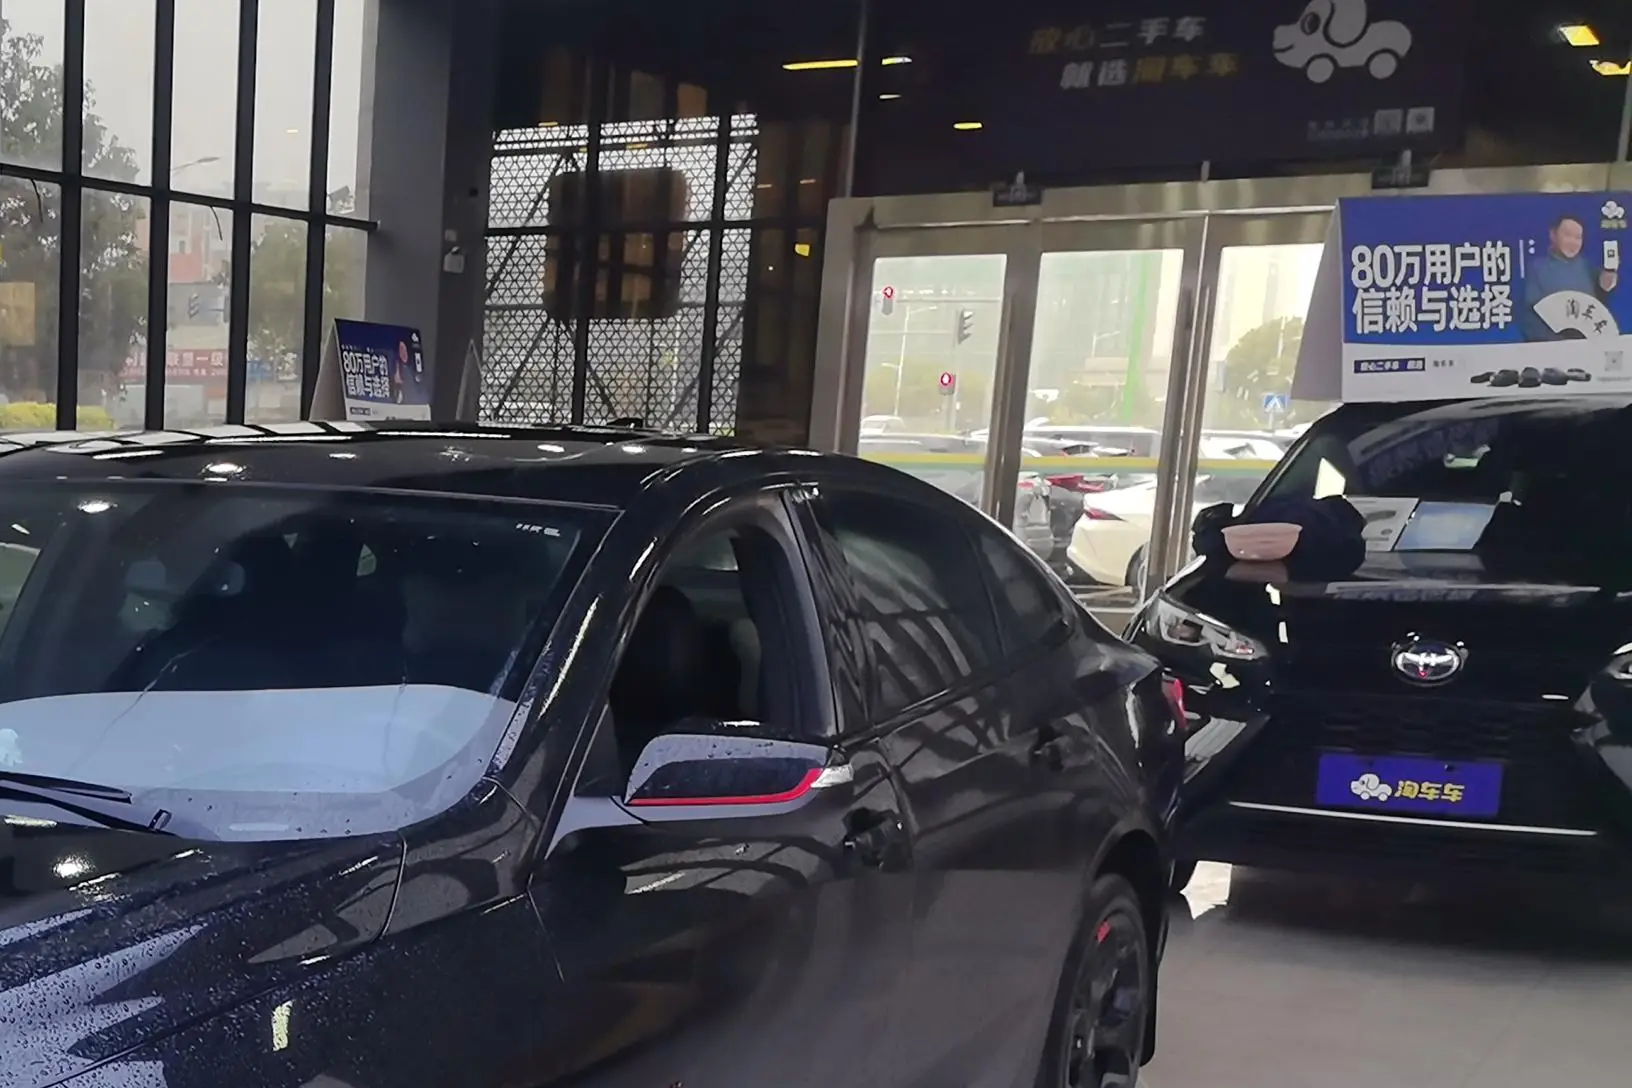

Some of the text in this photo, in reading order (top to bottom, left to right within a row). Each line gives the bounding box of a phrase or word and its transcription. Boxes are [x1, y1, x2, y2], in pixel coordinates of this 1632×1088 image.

[1350, 240, 1511, 289] 80万用户的
[1352, 284, 1513, 334] 信赖与选择
[1394, 780, 1465, 803] 淘车车
